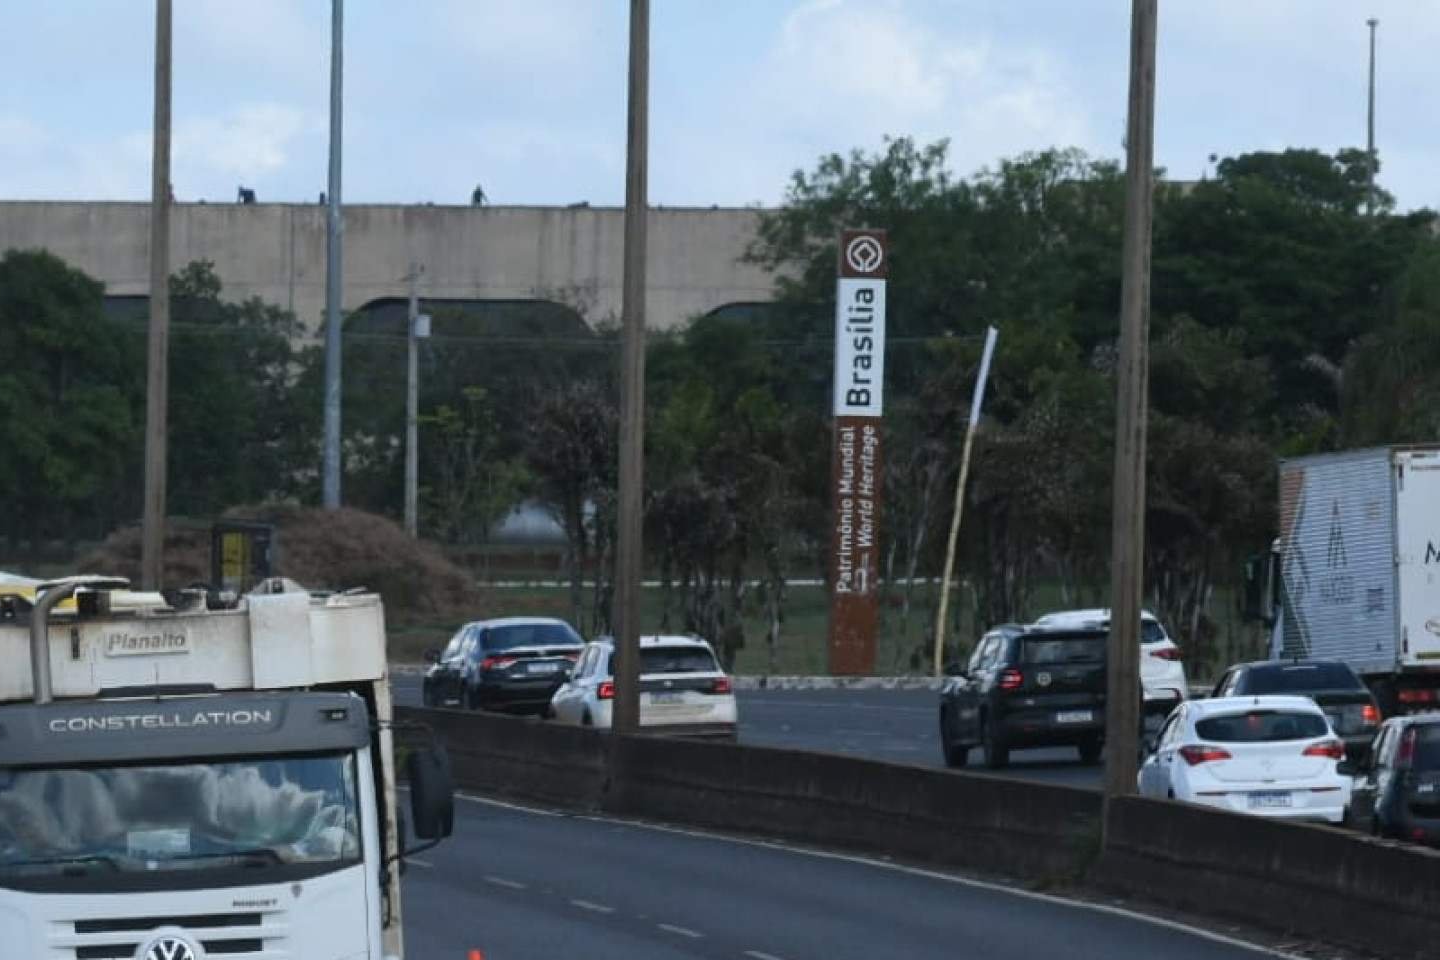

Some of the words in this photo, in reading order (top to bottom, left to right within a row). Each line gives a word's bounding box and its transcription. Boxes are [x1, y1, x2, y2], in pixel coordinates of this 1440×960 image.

[845, 287, 874, 407] Brasília
[838, 426, 855, 494] Mundial
[859, 424, 879, 496] Heritage
[836, 498, 853, 593] Patrimônio
[857, 499, 874, 547] World
[109, 631, 187, 650] Planalto
[48, 709, 272, 733] CONSTELLATION
